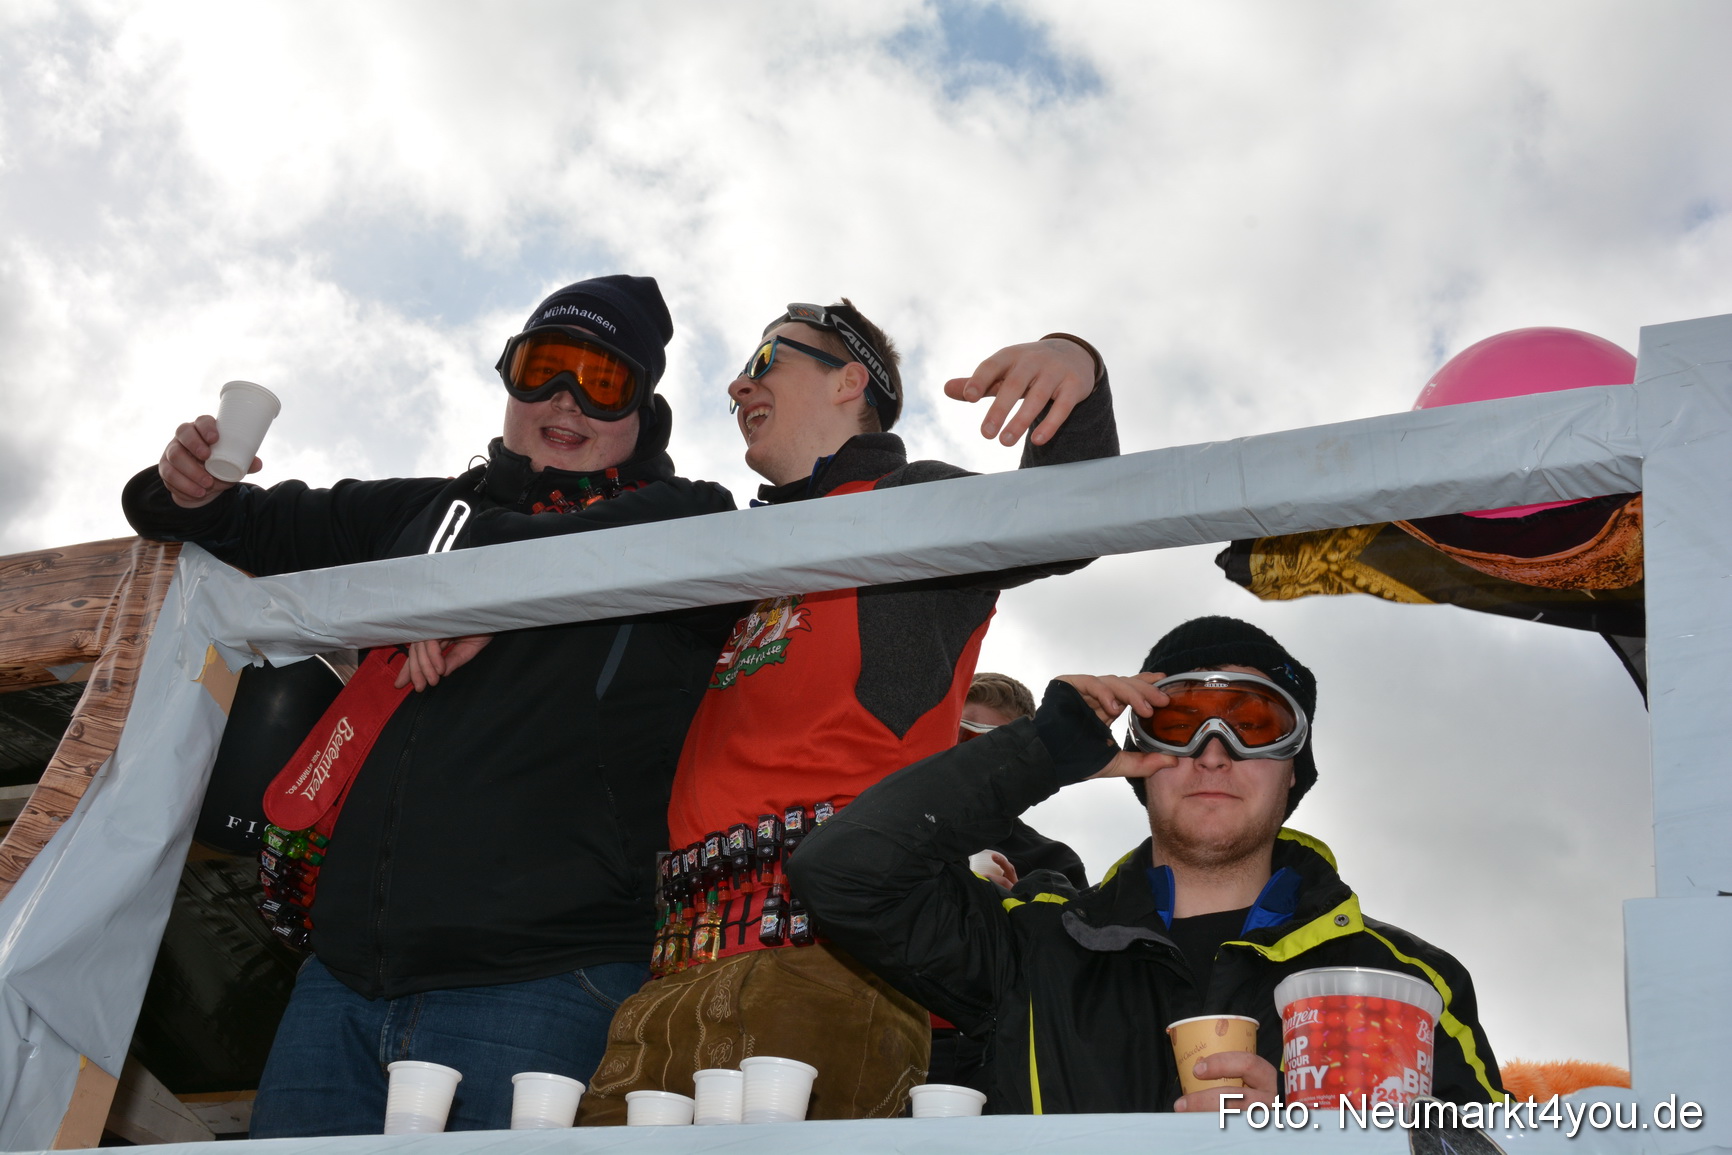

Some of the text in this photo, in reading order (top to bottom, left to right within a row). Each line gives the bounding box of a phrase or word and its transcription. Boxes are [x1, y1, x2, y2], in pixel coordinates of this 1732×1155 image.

[543, 305, 617, 335] Mühlhausen
[839, 329, 891, 391] ALPINA
[301, 716, 354, 801] Berentzen
[1288, 1054, 1310, 1070] YOUR
